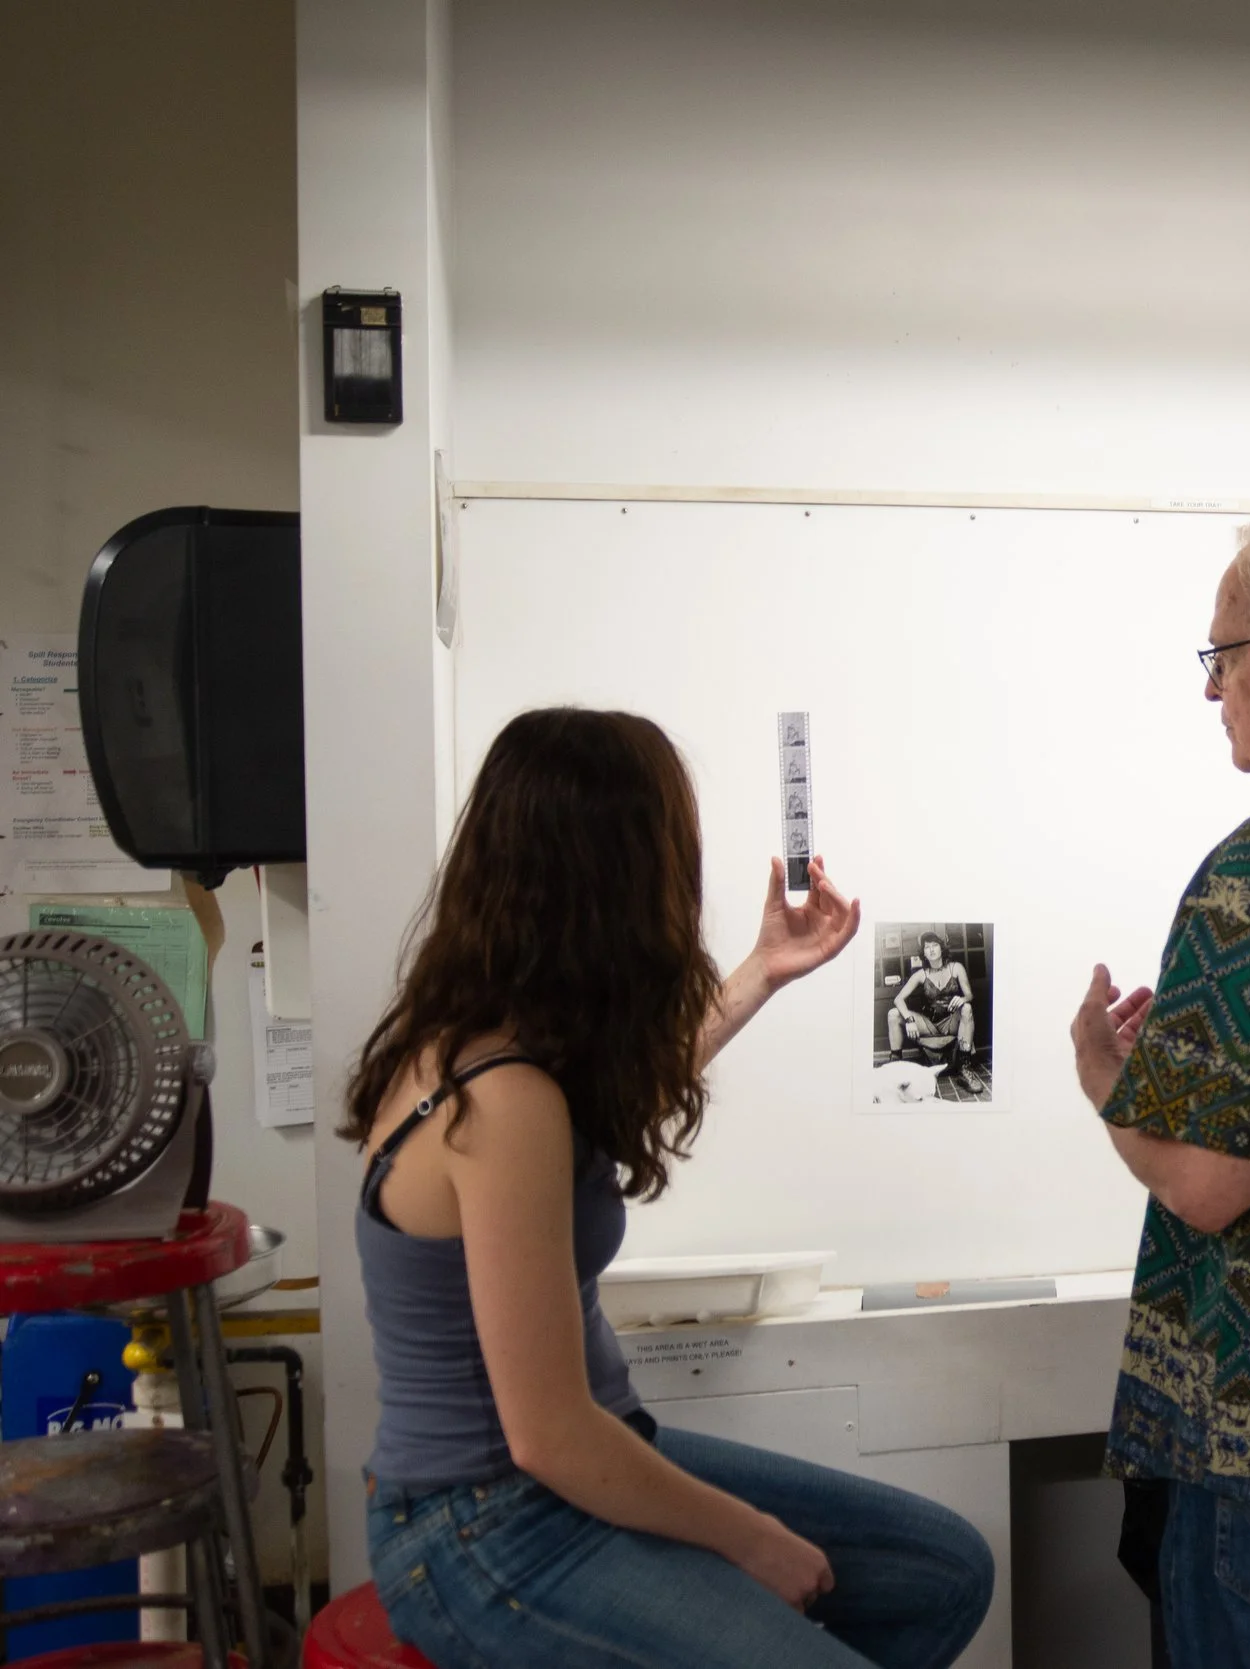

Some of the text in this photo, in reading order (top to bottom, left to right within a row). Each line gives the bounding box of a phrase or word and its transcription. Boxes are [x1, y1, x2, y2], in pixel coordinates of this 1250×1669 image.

[28, 651, 46, 659] Spill
[637, 1345, 653, 1353] THIS
[655, 1343, 674, 1352] AREA
[691, 1341, 708, 1349] WET
[709, 1339, 729, 1347] AREA
[644, 1357, 660, 1365] AND
[661, 1354, 688, 1363] PRINTS
[689, 1352, 709, 1361] ONLY
[711, 1349, 742, 1359] PLEASE!
